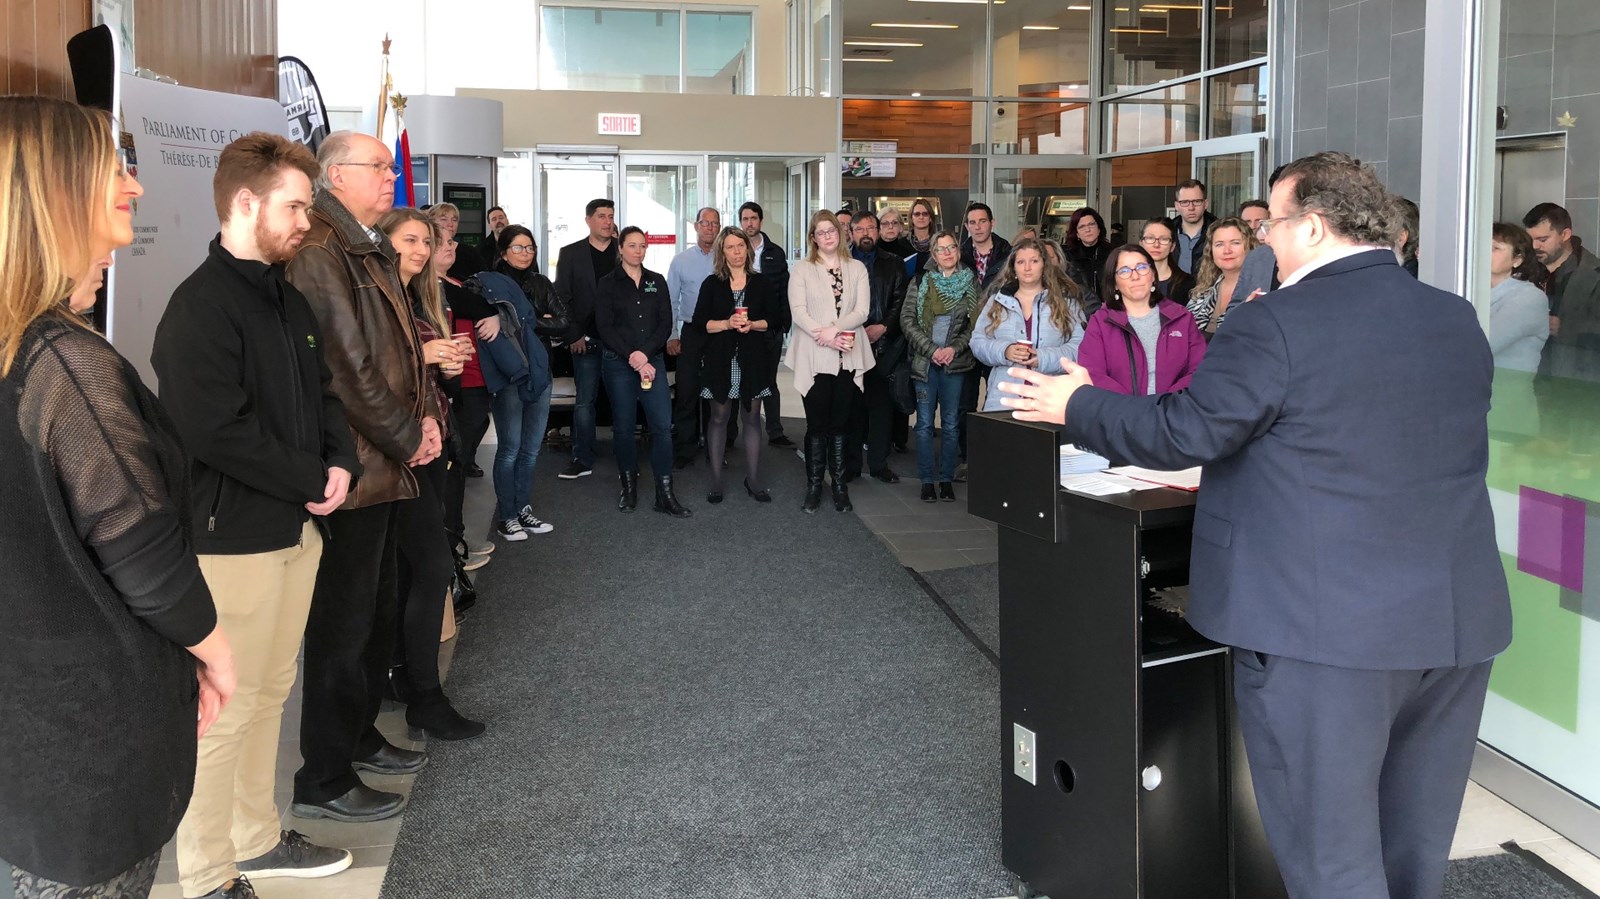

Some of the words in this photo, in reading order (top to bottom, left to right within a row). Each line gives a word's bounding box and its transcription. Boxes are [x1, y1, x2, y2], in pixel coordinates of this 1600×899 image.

[142, 116, 206, 142] PARLIAMENT
[211, 129, 225, 144] OF
[602, 116, 637, 132] SORTIE
